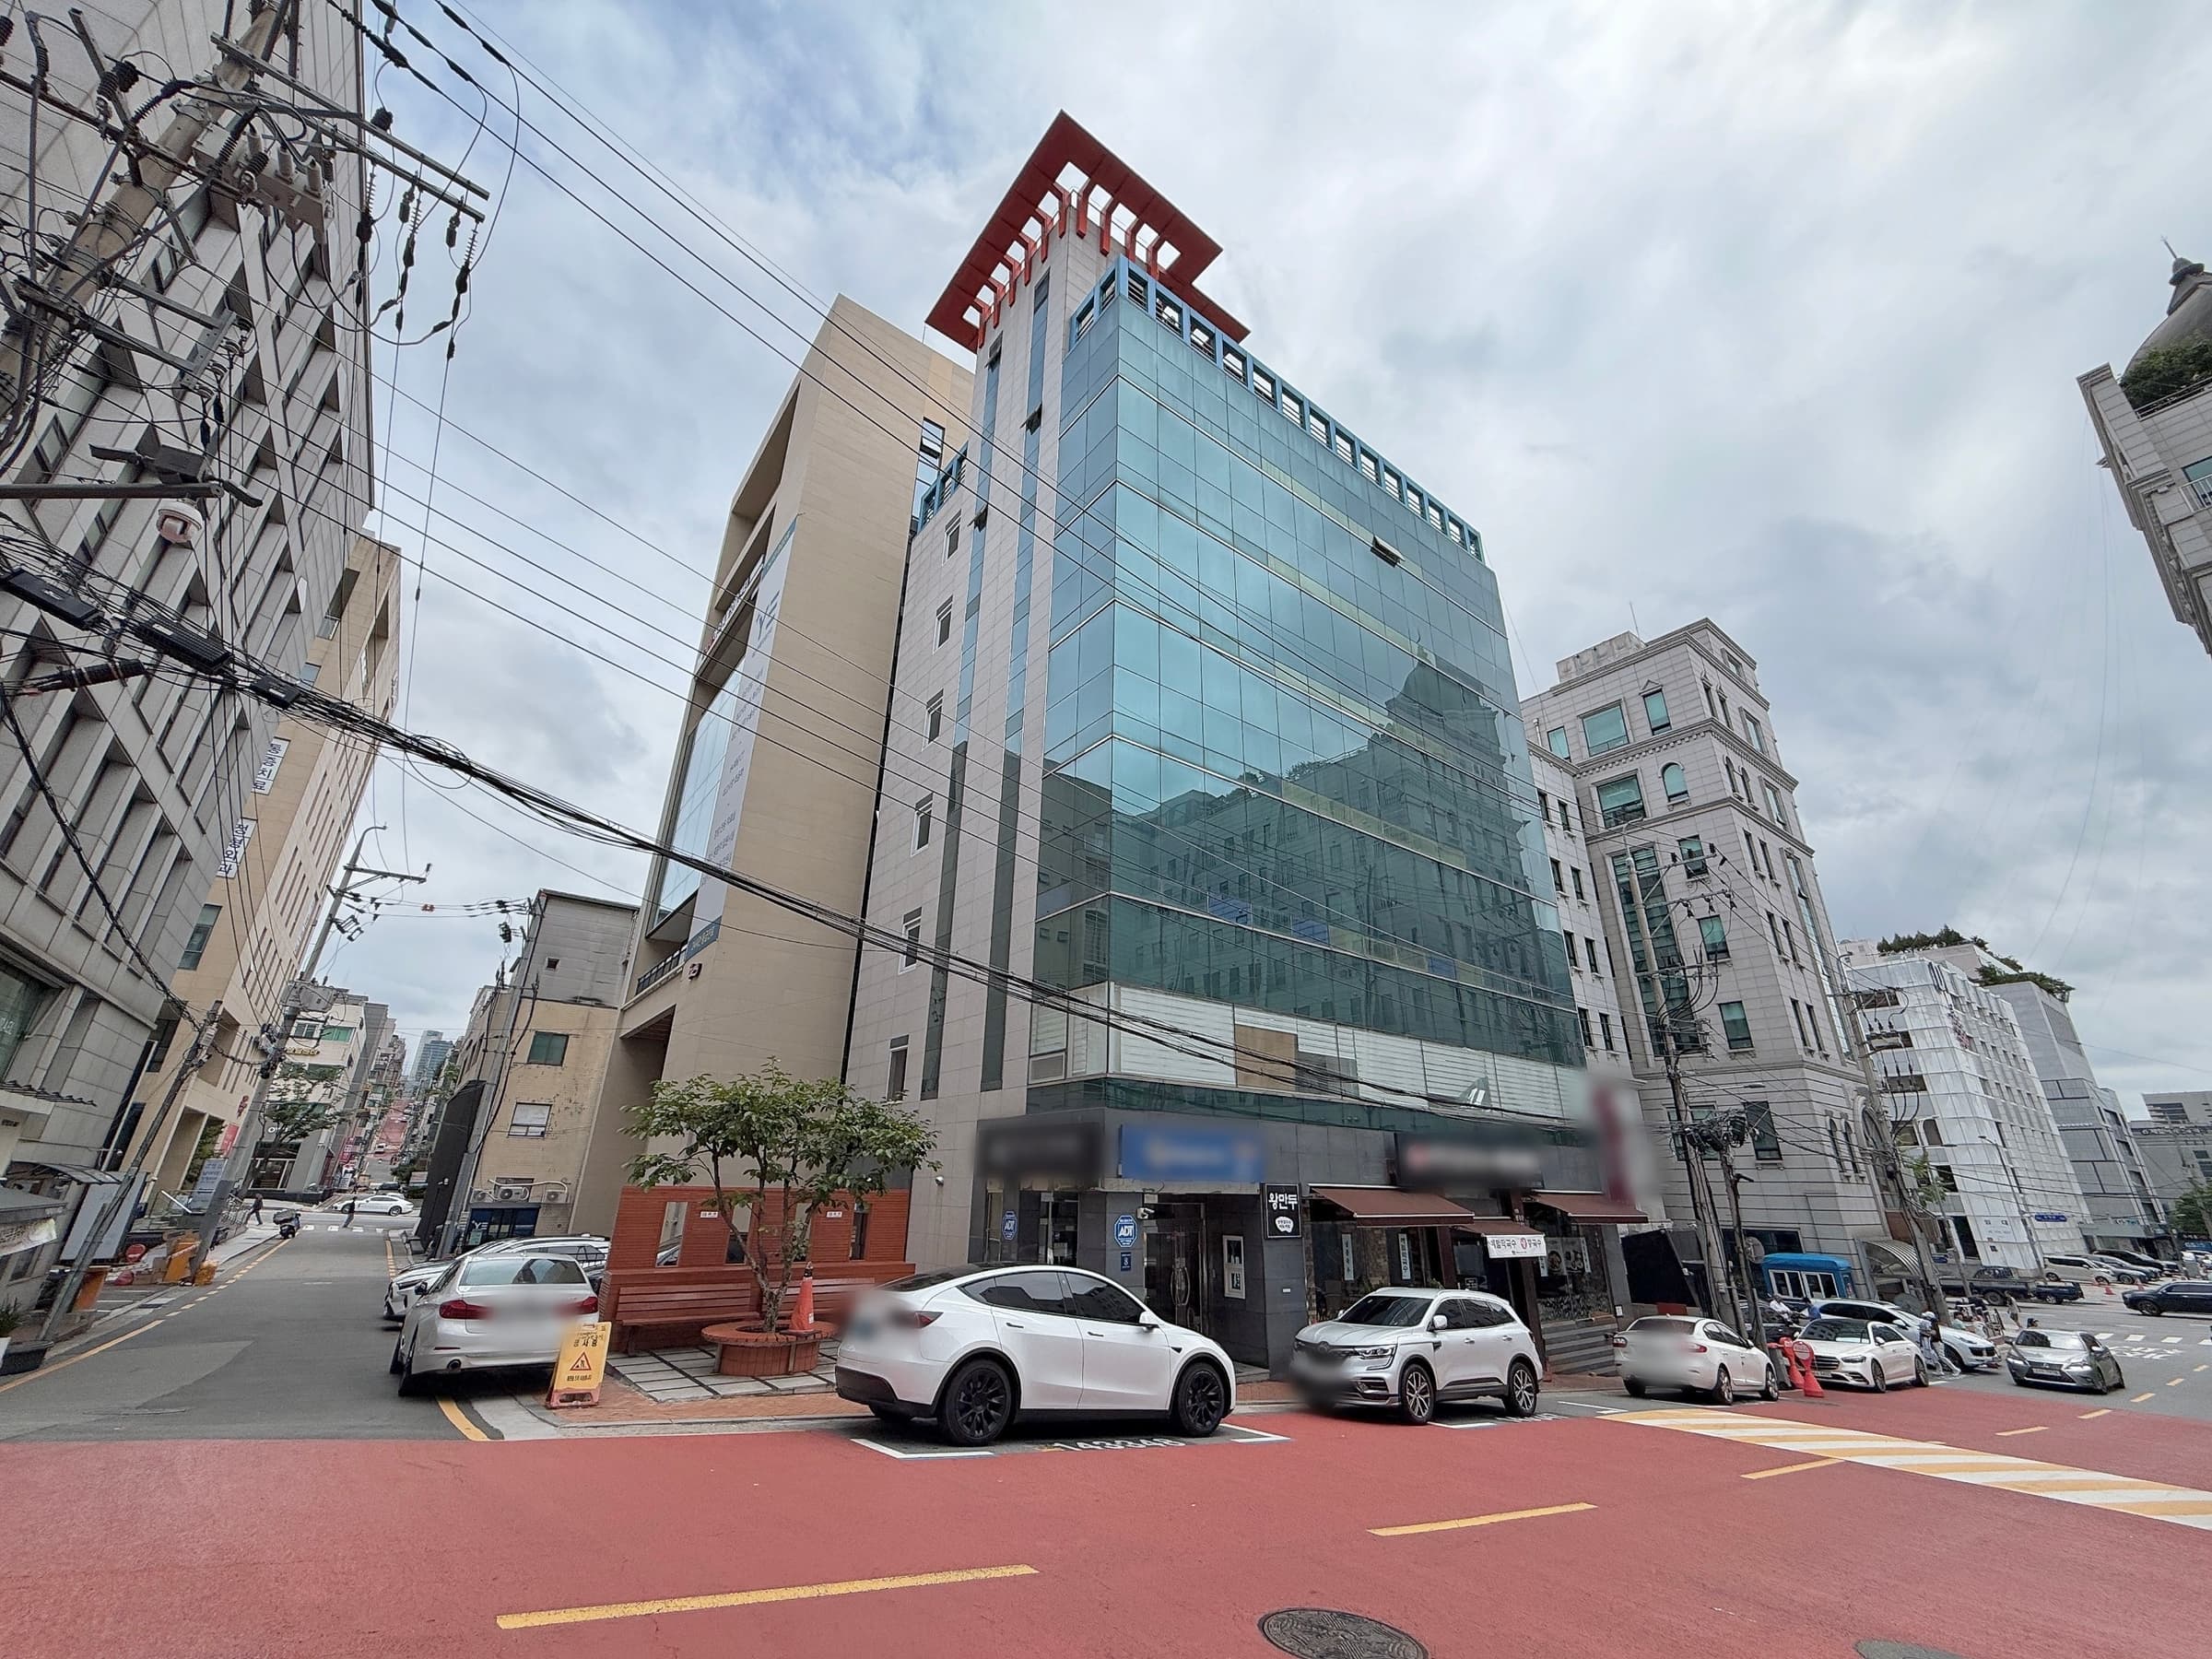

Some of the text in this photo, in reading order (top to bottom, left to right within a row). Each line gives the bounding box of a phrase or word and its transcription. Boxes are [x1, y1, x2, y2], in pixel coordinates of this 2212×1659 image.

[219, 824, 249, 875] 정형외과
[1268, 1193, 1298, 1210] 왕만두
[1005, 1220, 1015, 1231] ADT
[1119, 1226, 1134, 1237] ADT
